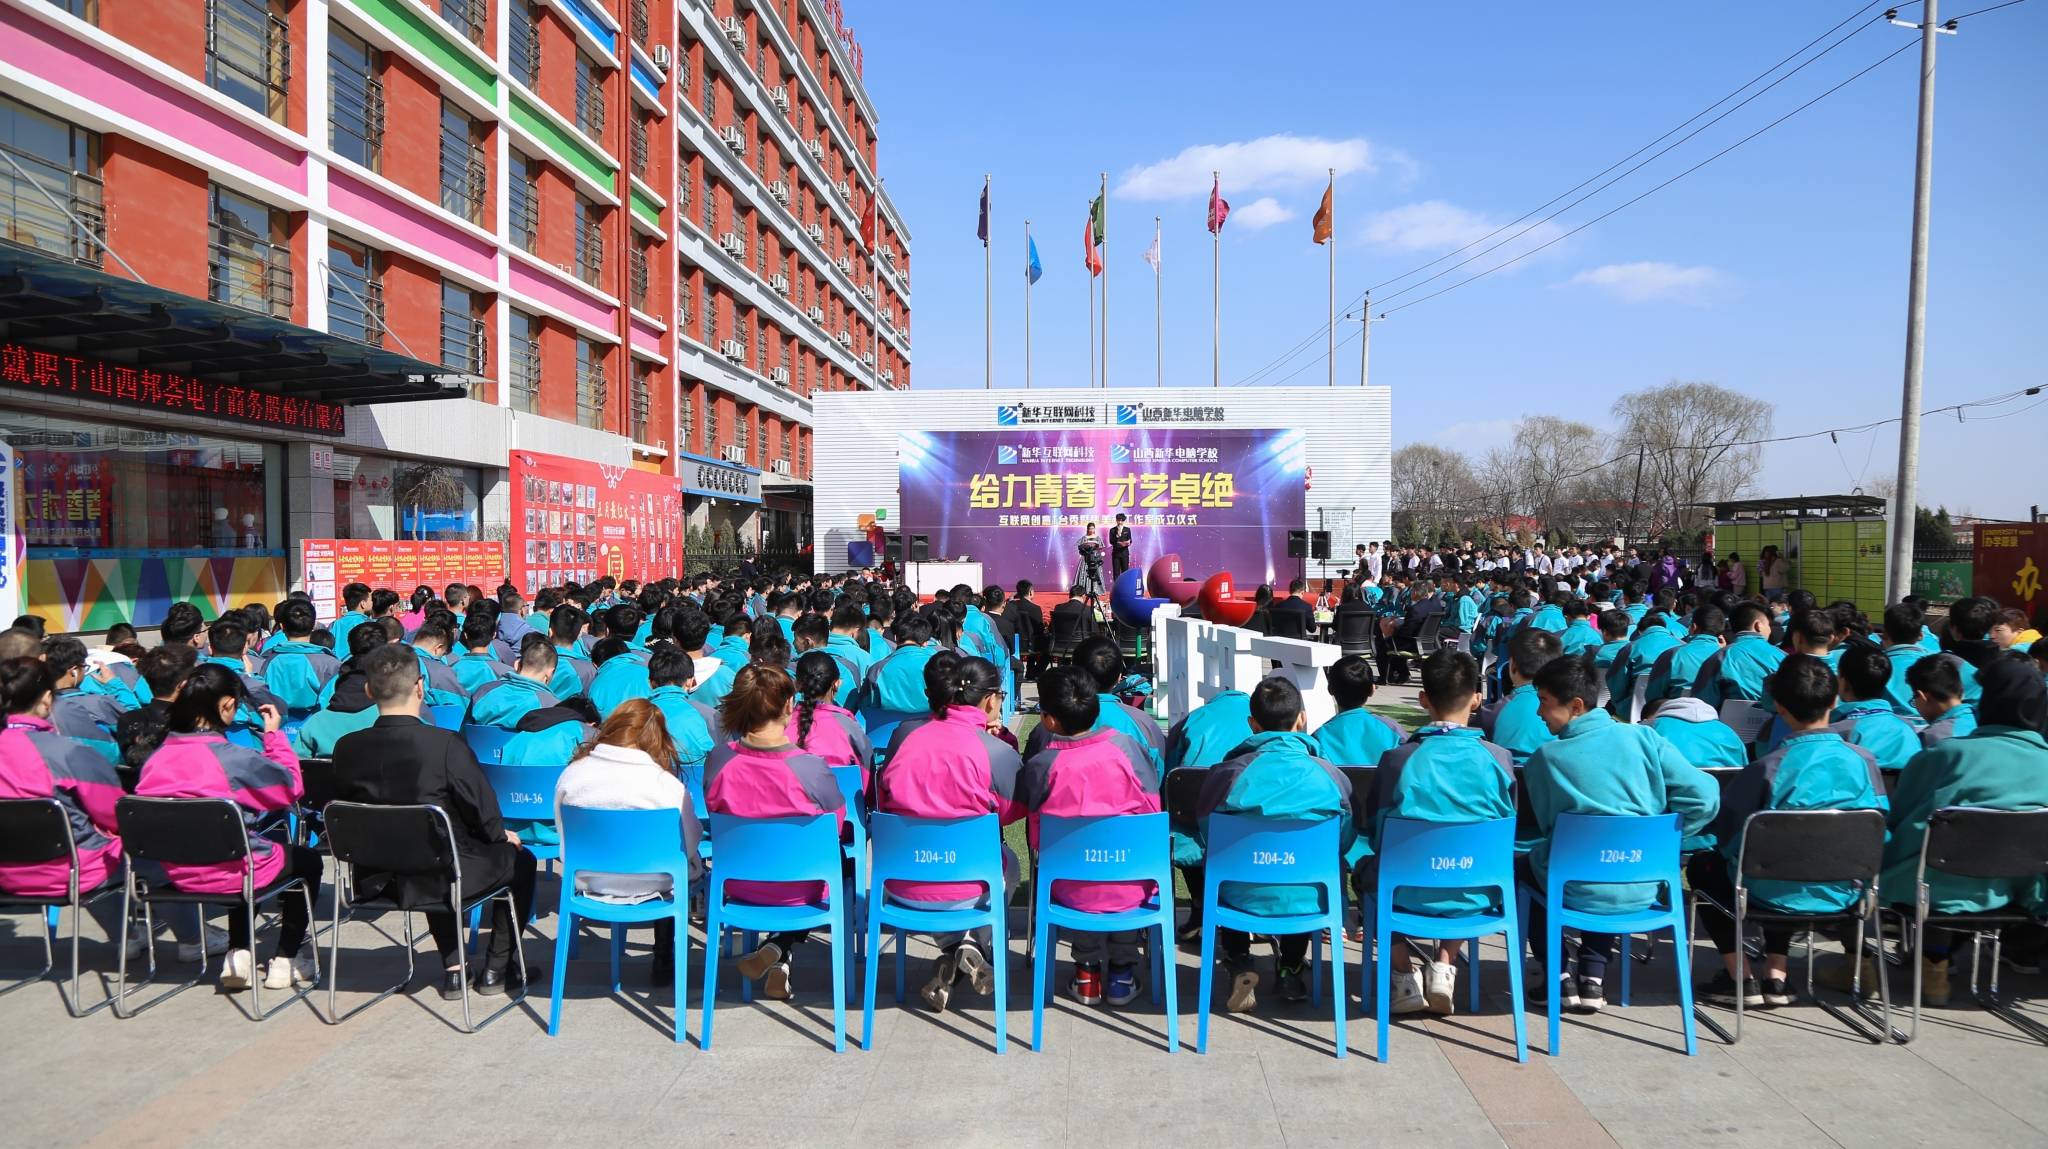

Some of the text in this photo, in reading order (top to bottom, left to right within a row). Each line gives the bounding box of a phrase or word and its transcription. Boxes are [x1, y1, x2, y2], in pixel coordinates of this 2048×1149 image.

[1022, 406, 1095, 418] 新华互联网科技
[1142, 406, 1225, 418] 山西新华电脑学校
[1022, 446, 1095, 458] 新华互联网科技
[1133, 446, 1218, 459] 山西新华电脑学校
[969, 472, 1234, 509] 给力青春 才艺卓绝
[510, 792, 543, 804] 1204-36
[914, 849, 956, 864] 1204-10
[1253, 851, 1296, 865] 1204-26
[1600, 849, 1642, 863] 1204-28
[1431, 856, 1473, 870] 1204-09
